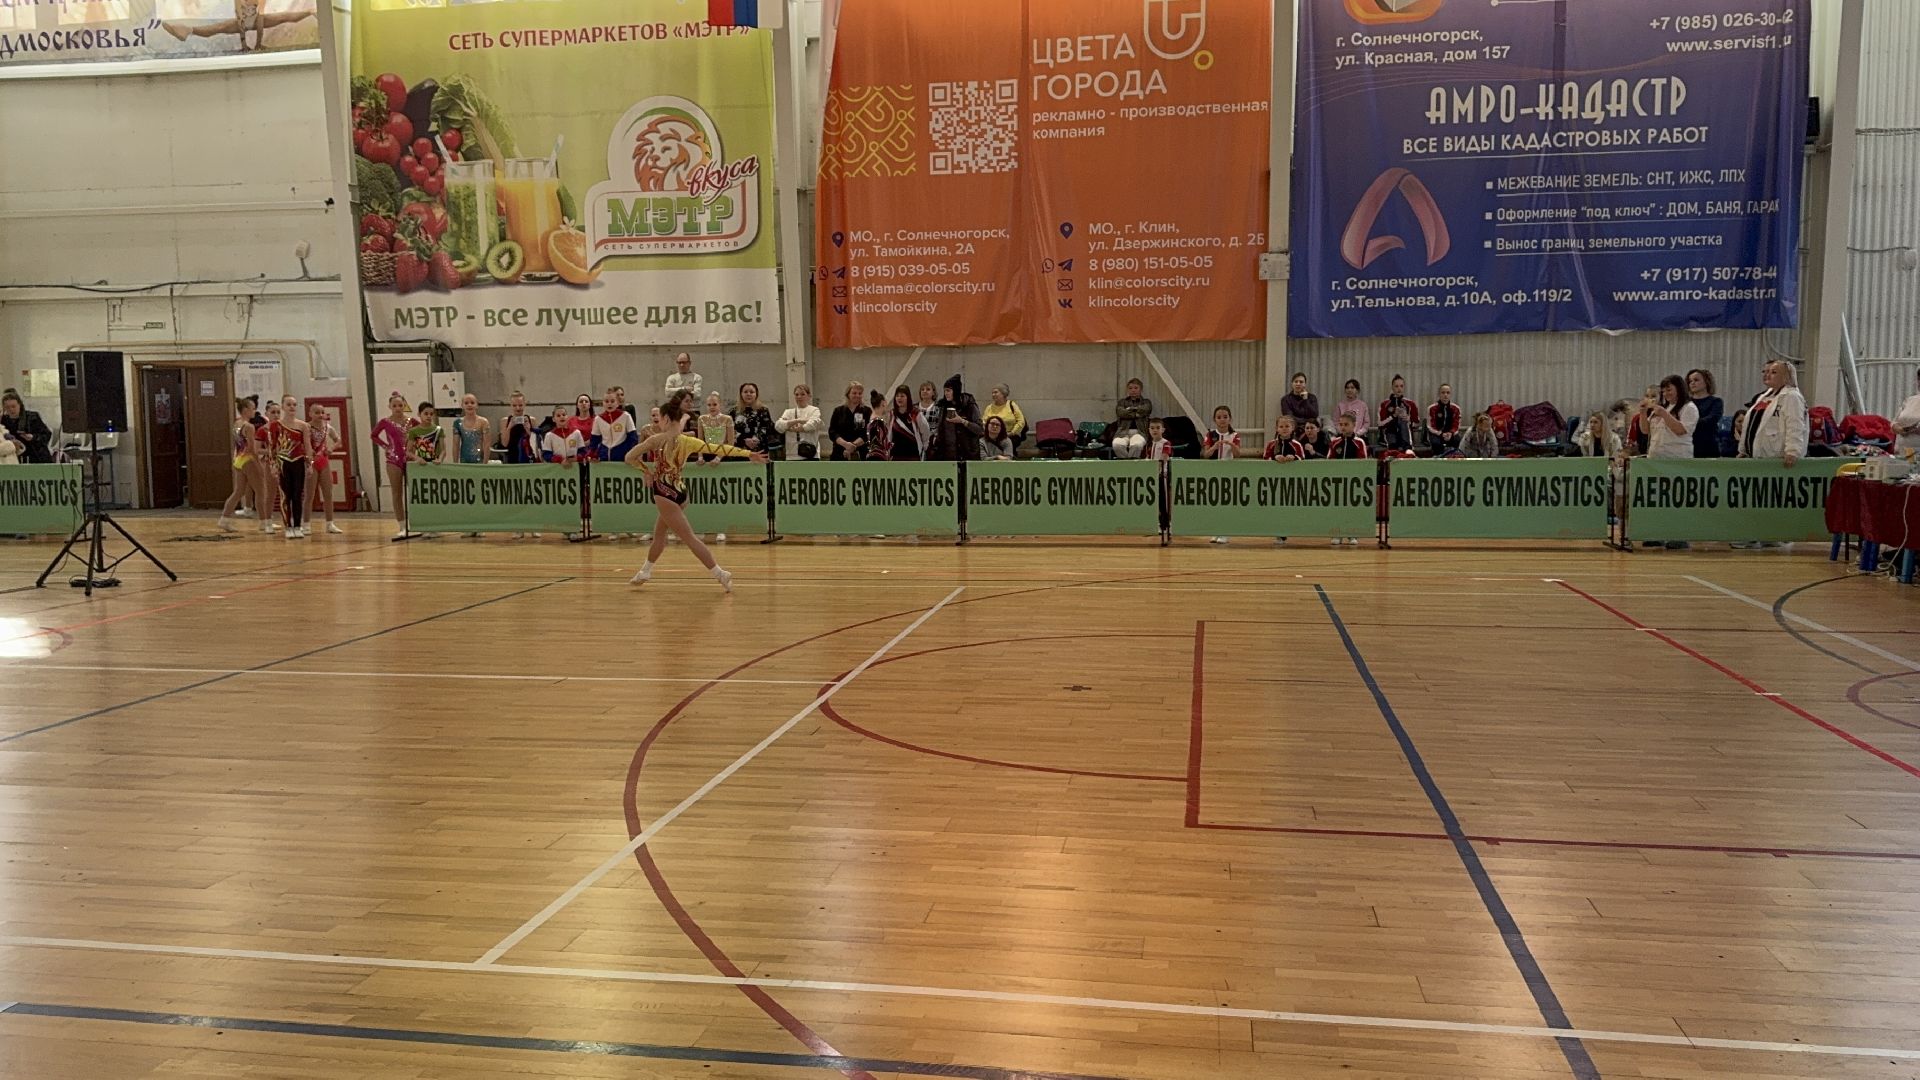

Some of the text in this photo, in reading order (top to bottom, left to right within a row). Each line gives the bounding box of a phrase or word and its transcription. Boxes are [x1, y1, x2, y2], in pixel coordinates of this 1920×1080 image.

[1650, 16, 1670, 30] +7
[1675, 14, 1718, 32] (985)
[449, 32, 494, 51] СЕТЬ
[499, 23, 667, 48] СУПЕРМАРКЕТОВ
[1336, 29, 1484, 47] г. Солнечногорск,
[1033, 33, 1136, 68] ЦВЕТА
[1336, 46, 1511, 70] ул. Красная, дом 157
[1033, 69, 1168, 101] ГОРОДА
[1425, 76, 1687, 126] АМРО-КАДАСТР
[1033, 108, 1106, 125] рекламно
[1120, 101, 1269, 120] производственная
[1033, 126, 1105, 139] компания
[1403, 126, 1709, 154] ВСЕ ВИДЫ КАДАСТРОВЫХ РАБОТ
[687, 155, 758, 204] вкуса
[1497, 169, 1746, 190] МЕЖЕВАНИЕ ЗЕМЕЛЬ: СНТ, ИЖС, ЛПХ
[607, 196, 734, 236] МЭТР
[1497, 207, 1577, 222] Оформление
[1666, 202, 1701, 218] ДОМ,
[1706, 200, 1744, 216] БАНЯ,
[884, 233, 893, 242] г.
[897, 228, 1010, 241] Солнечногорск,
[1125, 225, 1135, 234] г.
[1139, 221, 1180, 234] Клин,
[639, 241, 739, 250] СУПЕРМАРКЕТОВ
[850, 243, 975, 260] ул. Тамойкина, 2А
[1089, 240, 1108, 253] ул.
[1113, 235, 1226, 251] Дзержинского,
[1229, 237, 1242, 247] д.
[1496, 233, 1723, 251] Вынос границ земельного участка
[851, 263, 970, 279] 8 (915) 039-05-05
[1089, 256, 1213, 273] 8 (980) 151-05-05
[1641, 268, 1661, 281] +7
[1666, 267, 1707, 284] (917)
[851, 281, 996, 296] reklama@colorscity.ru
[1089, 275, 1210, 290] klin@colorscity.ru
[1331, 275, 1479, 290] г. Солнечногорск,
[851, 301, 938, 314] klincolorscity
[1089, 294, 1181, 309] klincolorscity
[1331, 289, 1573, 312] ул.Тельнова, д.10А, оф.119/2
[395, 306, 458, 329] МЭТР
[484, 308, 529, 327] все
[535, 305, 638, 331] лучшее
[644, 304, 697, 328] для
[705, 301, 763, 324] Вас!
[411, 478, 577, 505] AEROBIC GYMNASTICS
[682, 477, 763, 505] MNASTICS
[779, 477, 954, 507] AEROBIC GYMNASTICS
[970, 476, 1155, 506] AEROBIC GYMNASTICS
[1174, 476, 1374, 507] AEROBIC GYMNASTICS
[1393, 475, 1605, 507] AEROBIC GYMNASTICS
[1632, 476, 1834, 509] AEROBIC GYMNASTI
